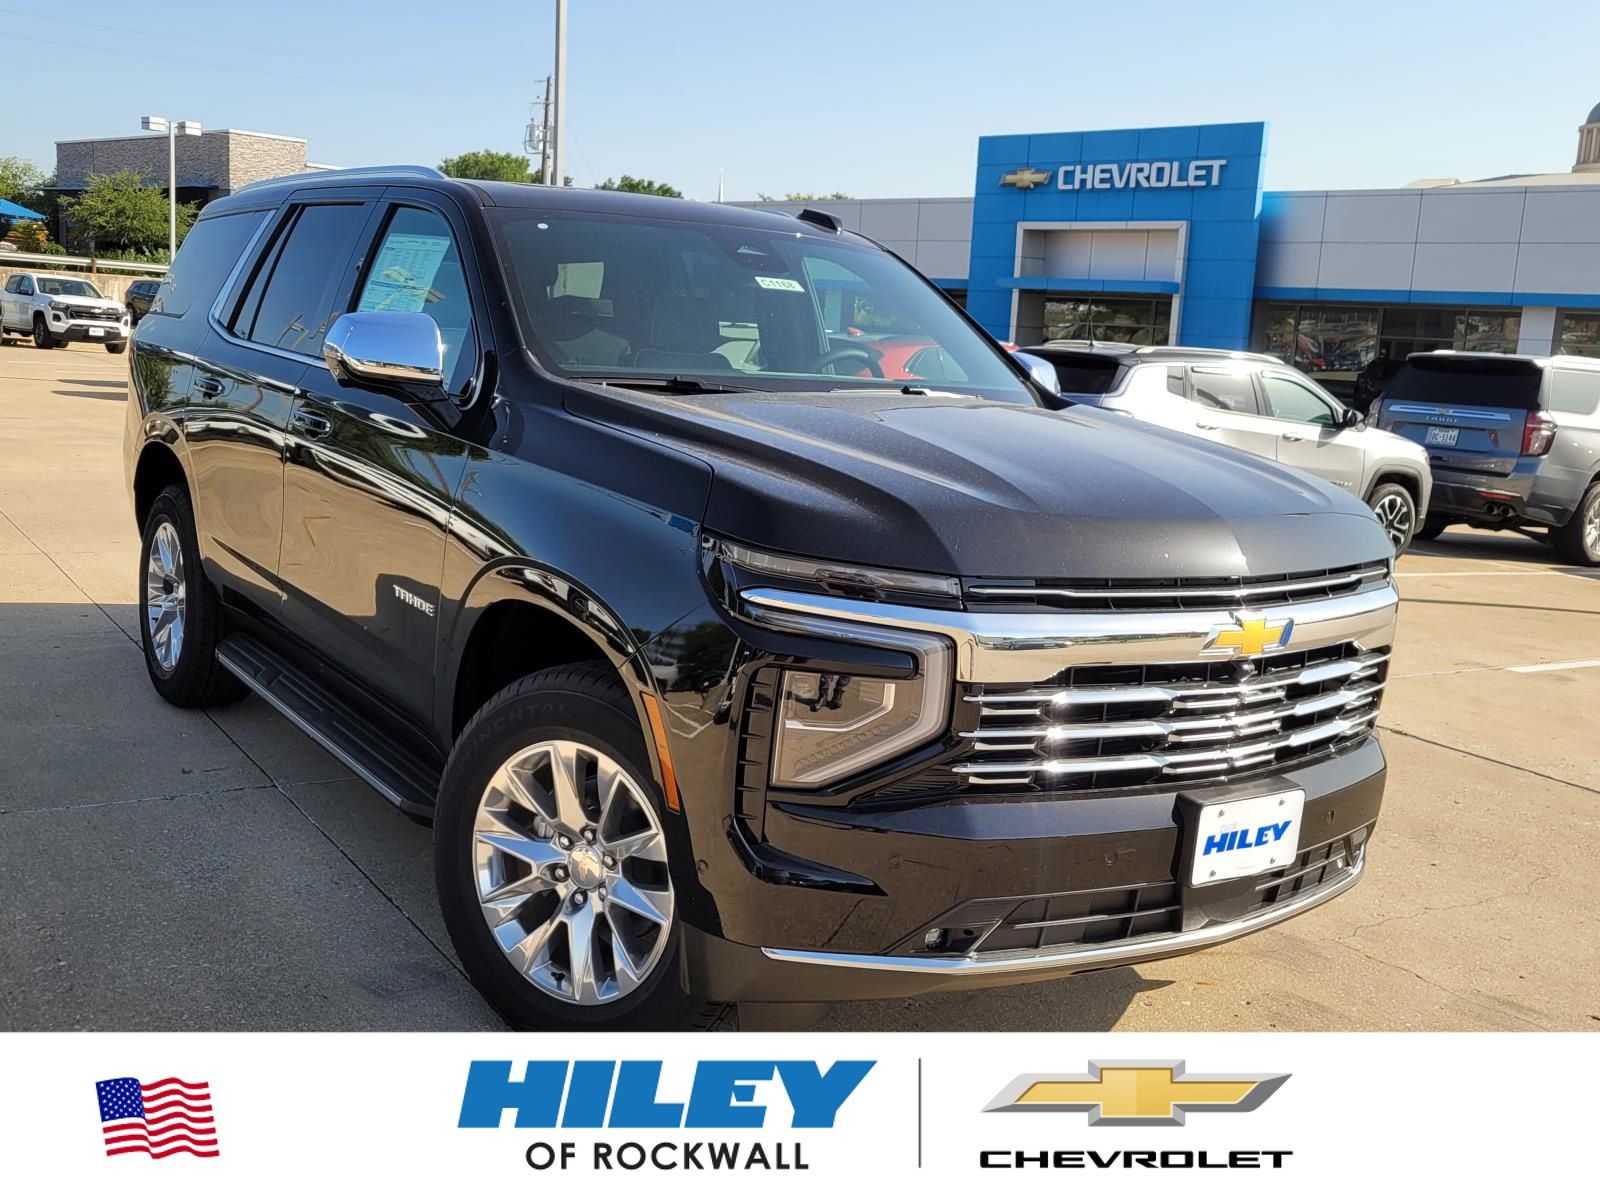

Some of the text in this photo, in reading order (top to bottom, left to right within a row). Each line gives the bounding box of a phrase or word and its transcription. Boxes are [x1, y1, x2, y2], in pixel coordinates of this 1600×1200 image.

[1057, 159, 1227, 190] CHEVROLET
[392, 584, 436, 617] TAHOE
[1202, 820, 1292, 856] HILEY
